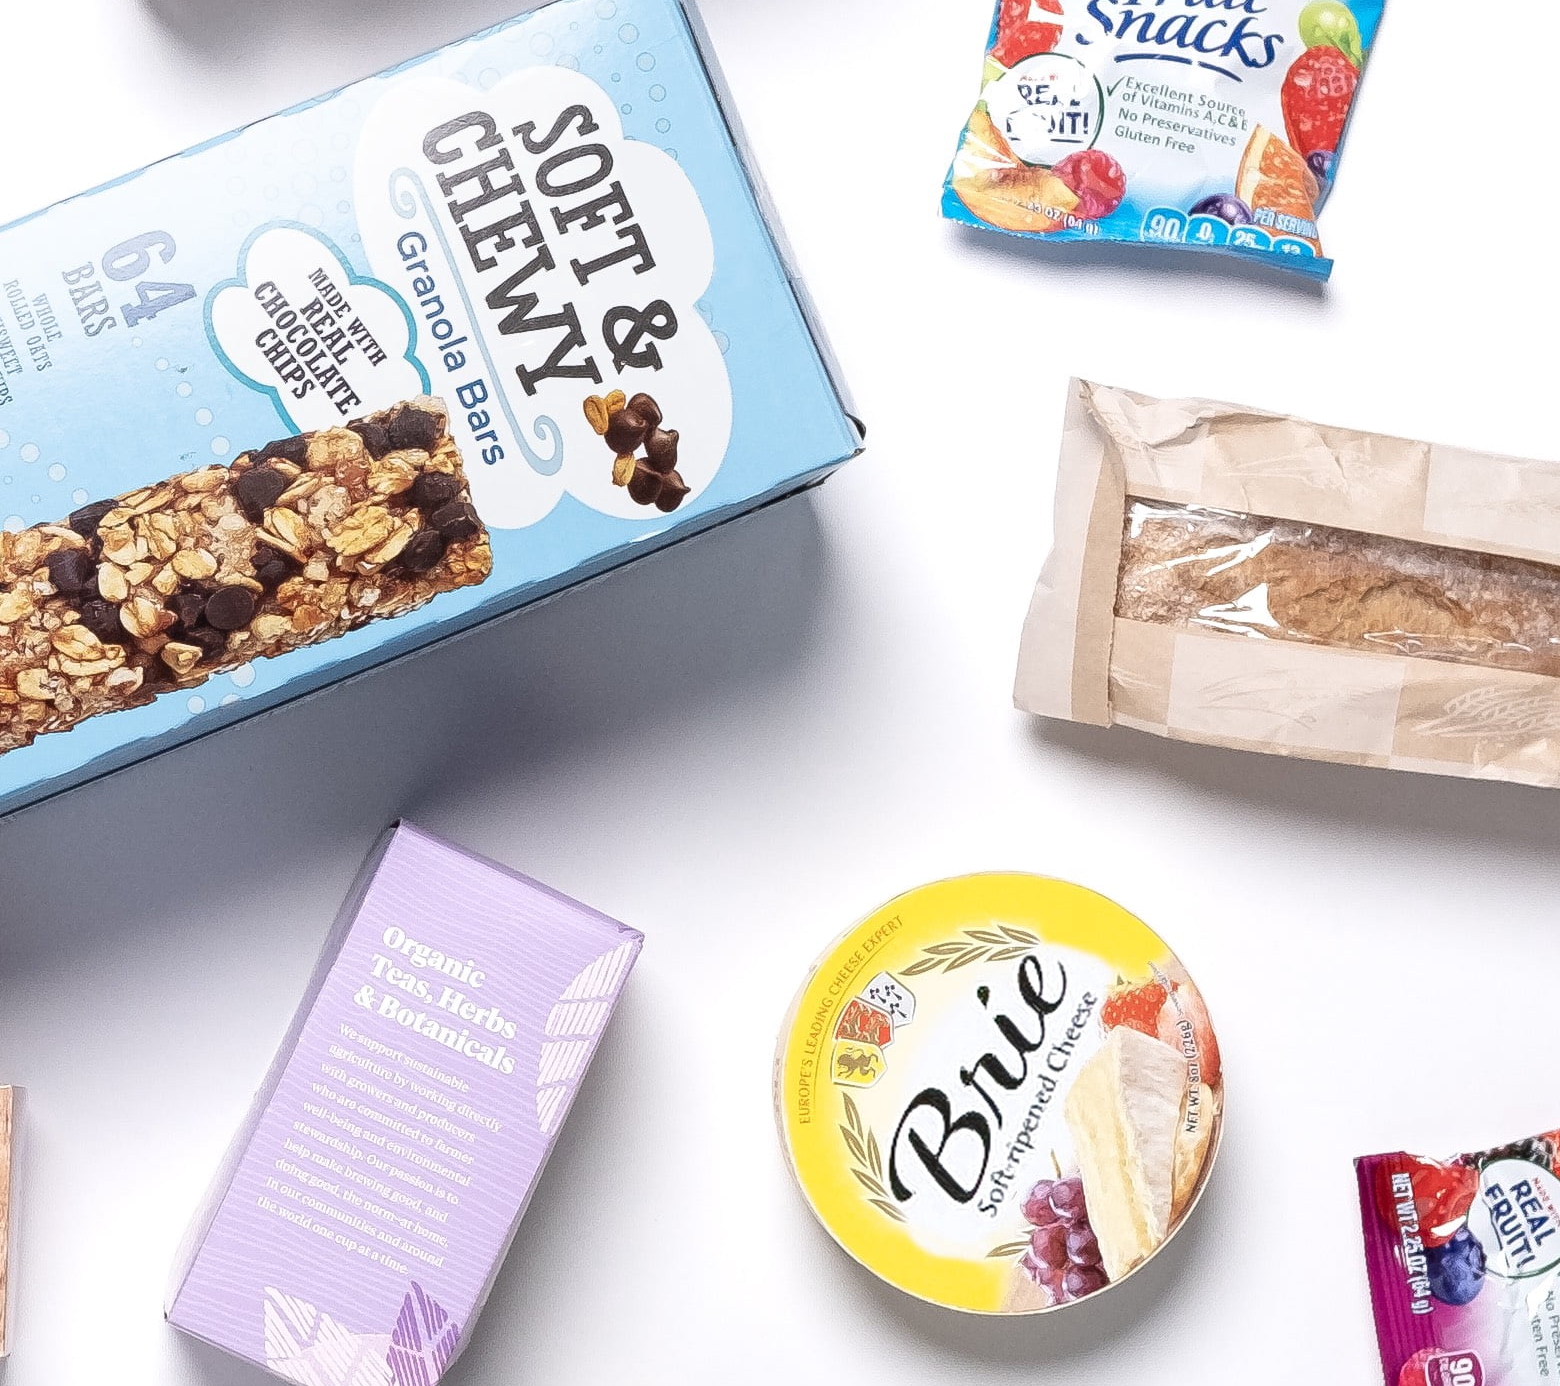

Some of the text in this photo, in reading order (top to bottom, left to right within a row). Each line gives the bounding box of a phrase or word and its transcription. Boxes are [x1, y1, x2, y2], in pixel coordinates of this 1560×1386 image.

[1114, 125, 1196, 154] Gluten Free
[1142, 112, 1237, 147] Preservatives
[101, 229, 198, 329] 64
[422, 110, 604, 397] CHEWY
[510, 104, 679, 375] SOFT &
[32, 292, 64, 343] WHOLE
[61, 261, 118, 338] BARS
[299, 296, 356, 366] REAL
[307, 267, 388, 367] MADE WITH
[26, 335, 53, 373] OATS
[253, 280, 362, 416] CHOCOLATE
[255, 327, 317, 399] CHIPS
[396, 230, 506, 465] Granola Bars
[369, 952, 518, 1042] Teas, Herbs
[381, 924, 487, 990] Organic
[805, 915, 904, 1060] LEADING CHEESE EXPERT
[372, 989, 516, 1077] Botanicals
[404, 1053, 471, 1093] sustainable
[410, 1079, 456, 1112] working
[887, 954, 1068, 1205] Brie
[977, 989, 1099, 1218] Soft-ripened Cheese
[1484, 1183, 1536, 1269] FRUIT!
[1509, 1179, 1558, 1247] REAL
